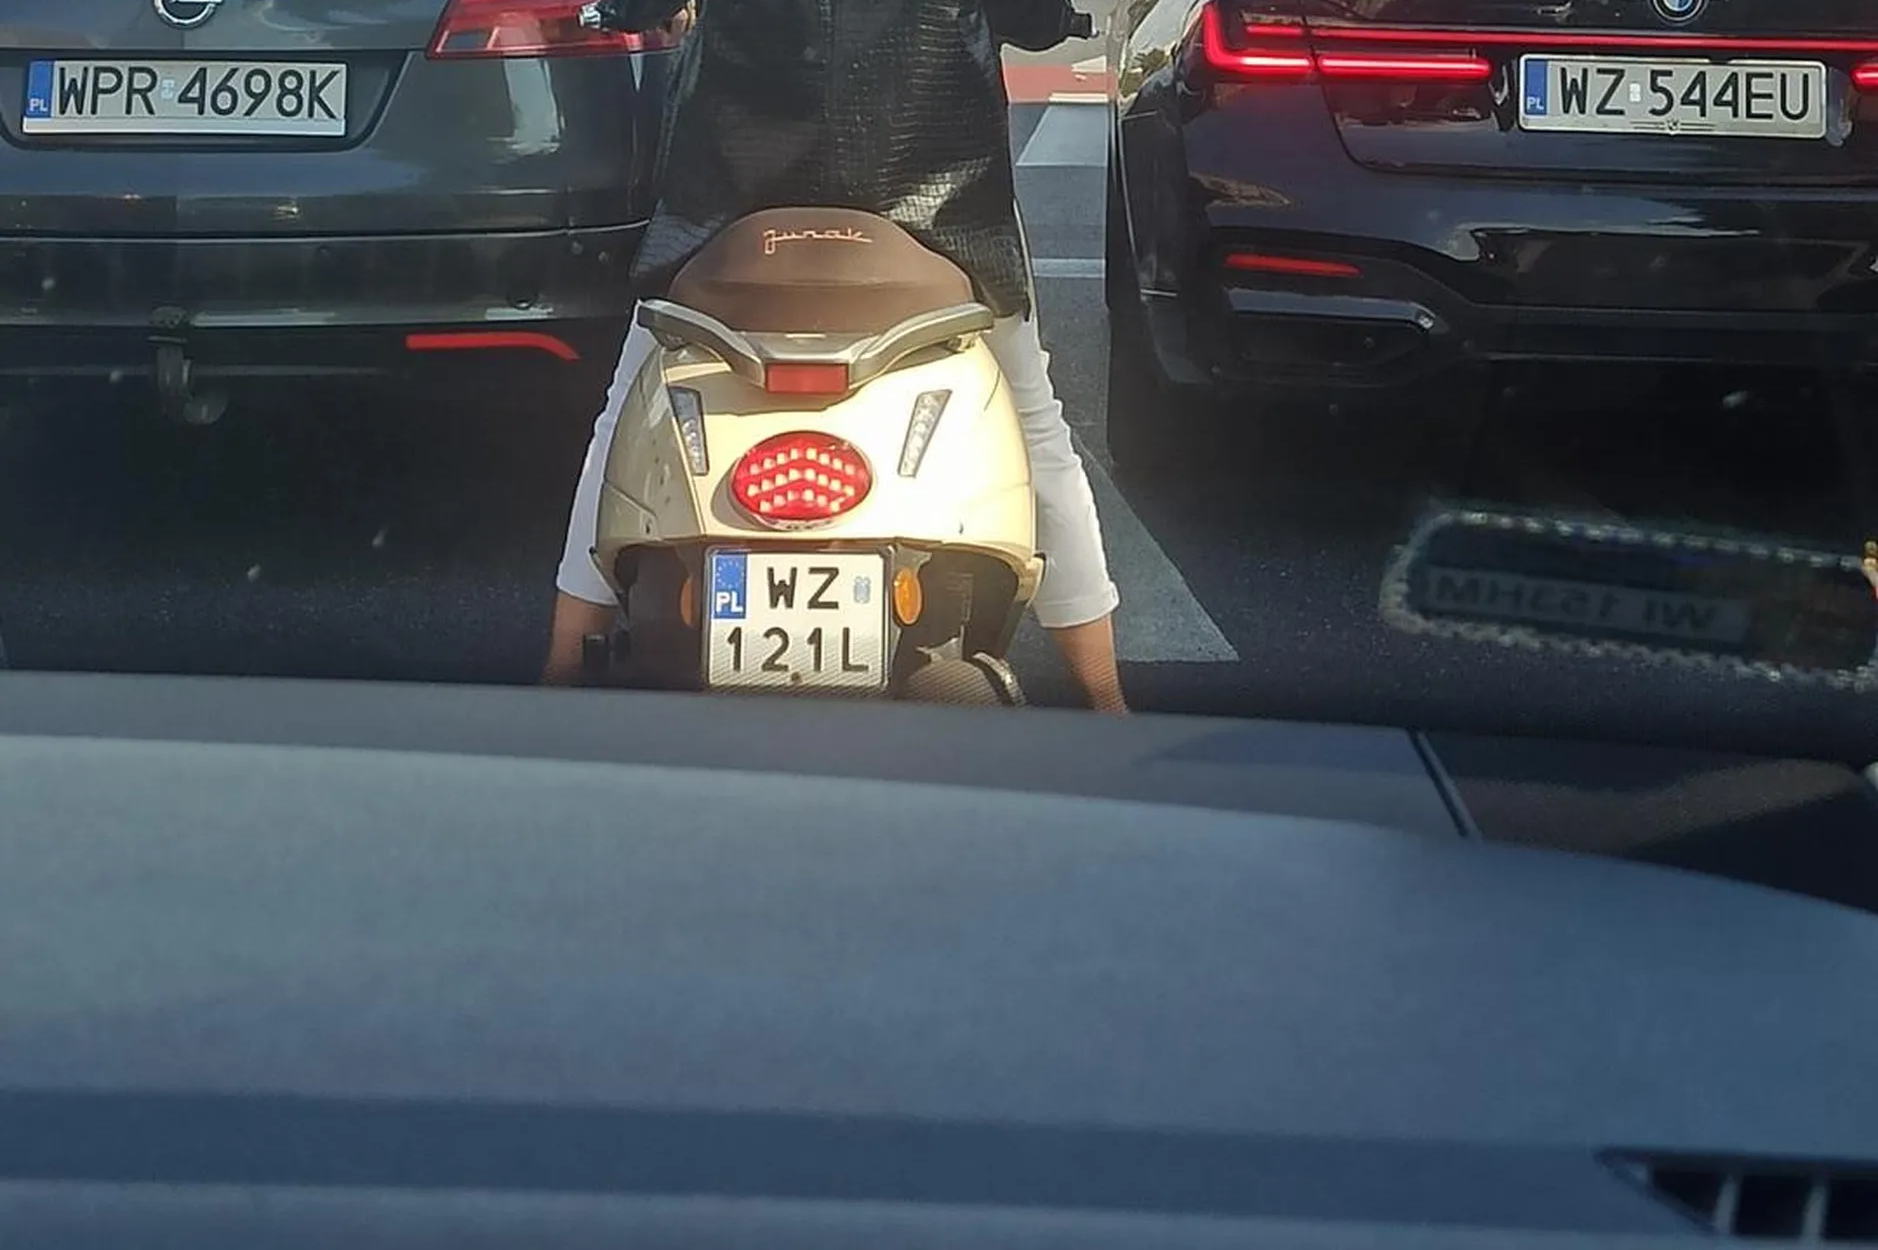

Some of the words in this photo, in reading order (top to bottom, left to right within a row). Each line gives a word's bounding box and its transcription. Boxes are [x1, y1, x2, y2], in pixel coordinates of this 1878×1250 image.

[29, 97, 48, 112] PL
[57, 65, 158, 116] WPR
[177, 66, 342, 120] 4698K
[1526, 96, 1545, 112] PL
[1560, 66, 1626, 117] WZ
[1648, 69, 1810, 121] 544EU
[715, 591, 744, 613] PL
[767, 566, 840, 610] WZ
[726, 626, 870, 672] 121L
